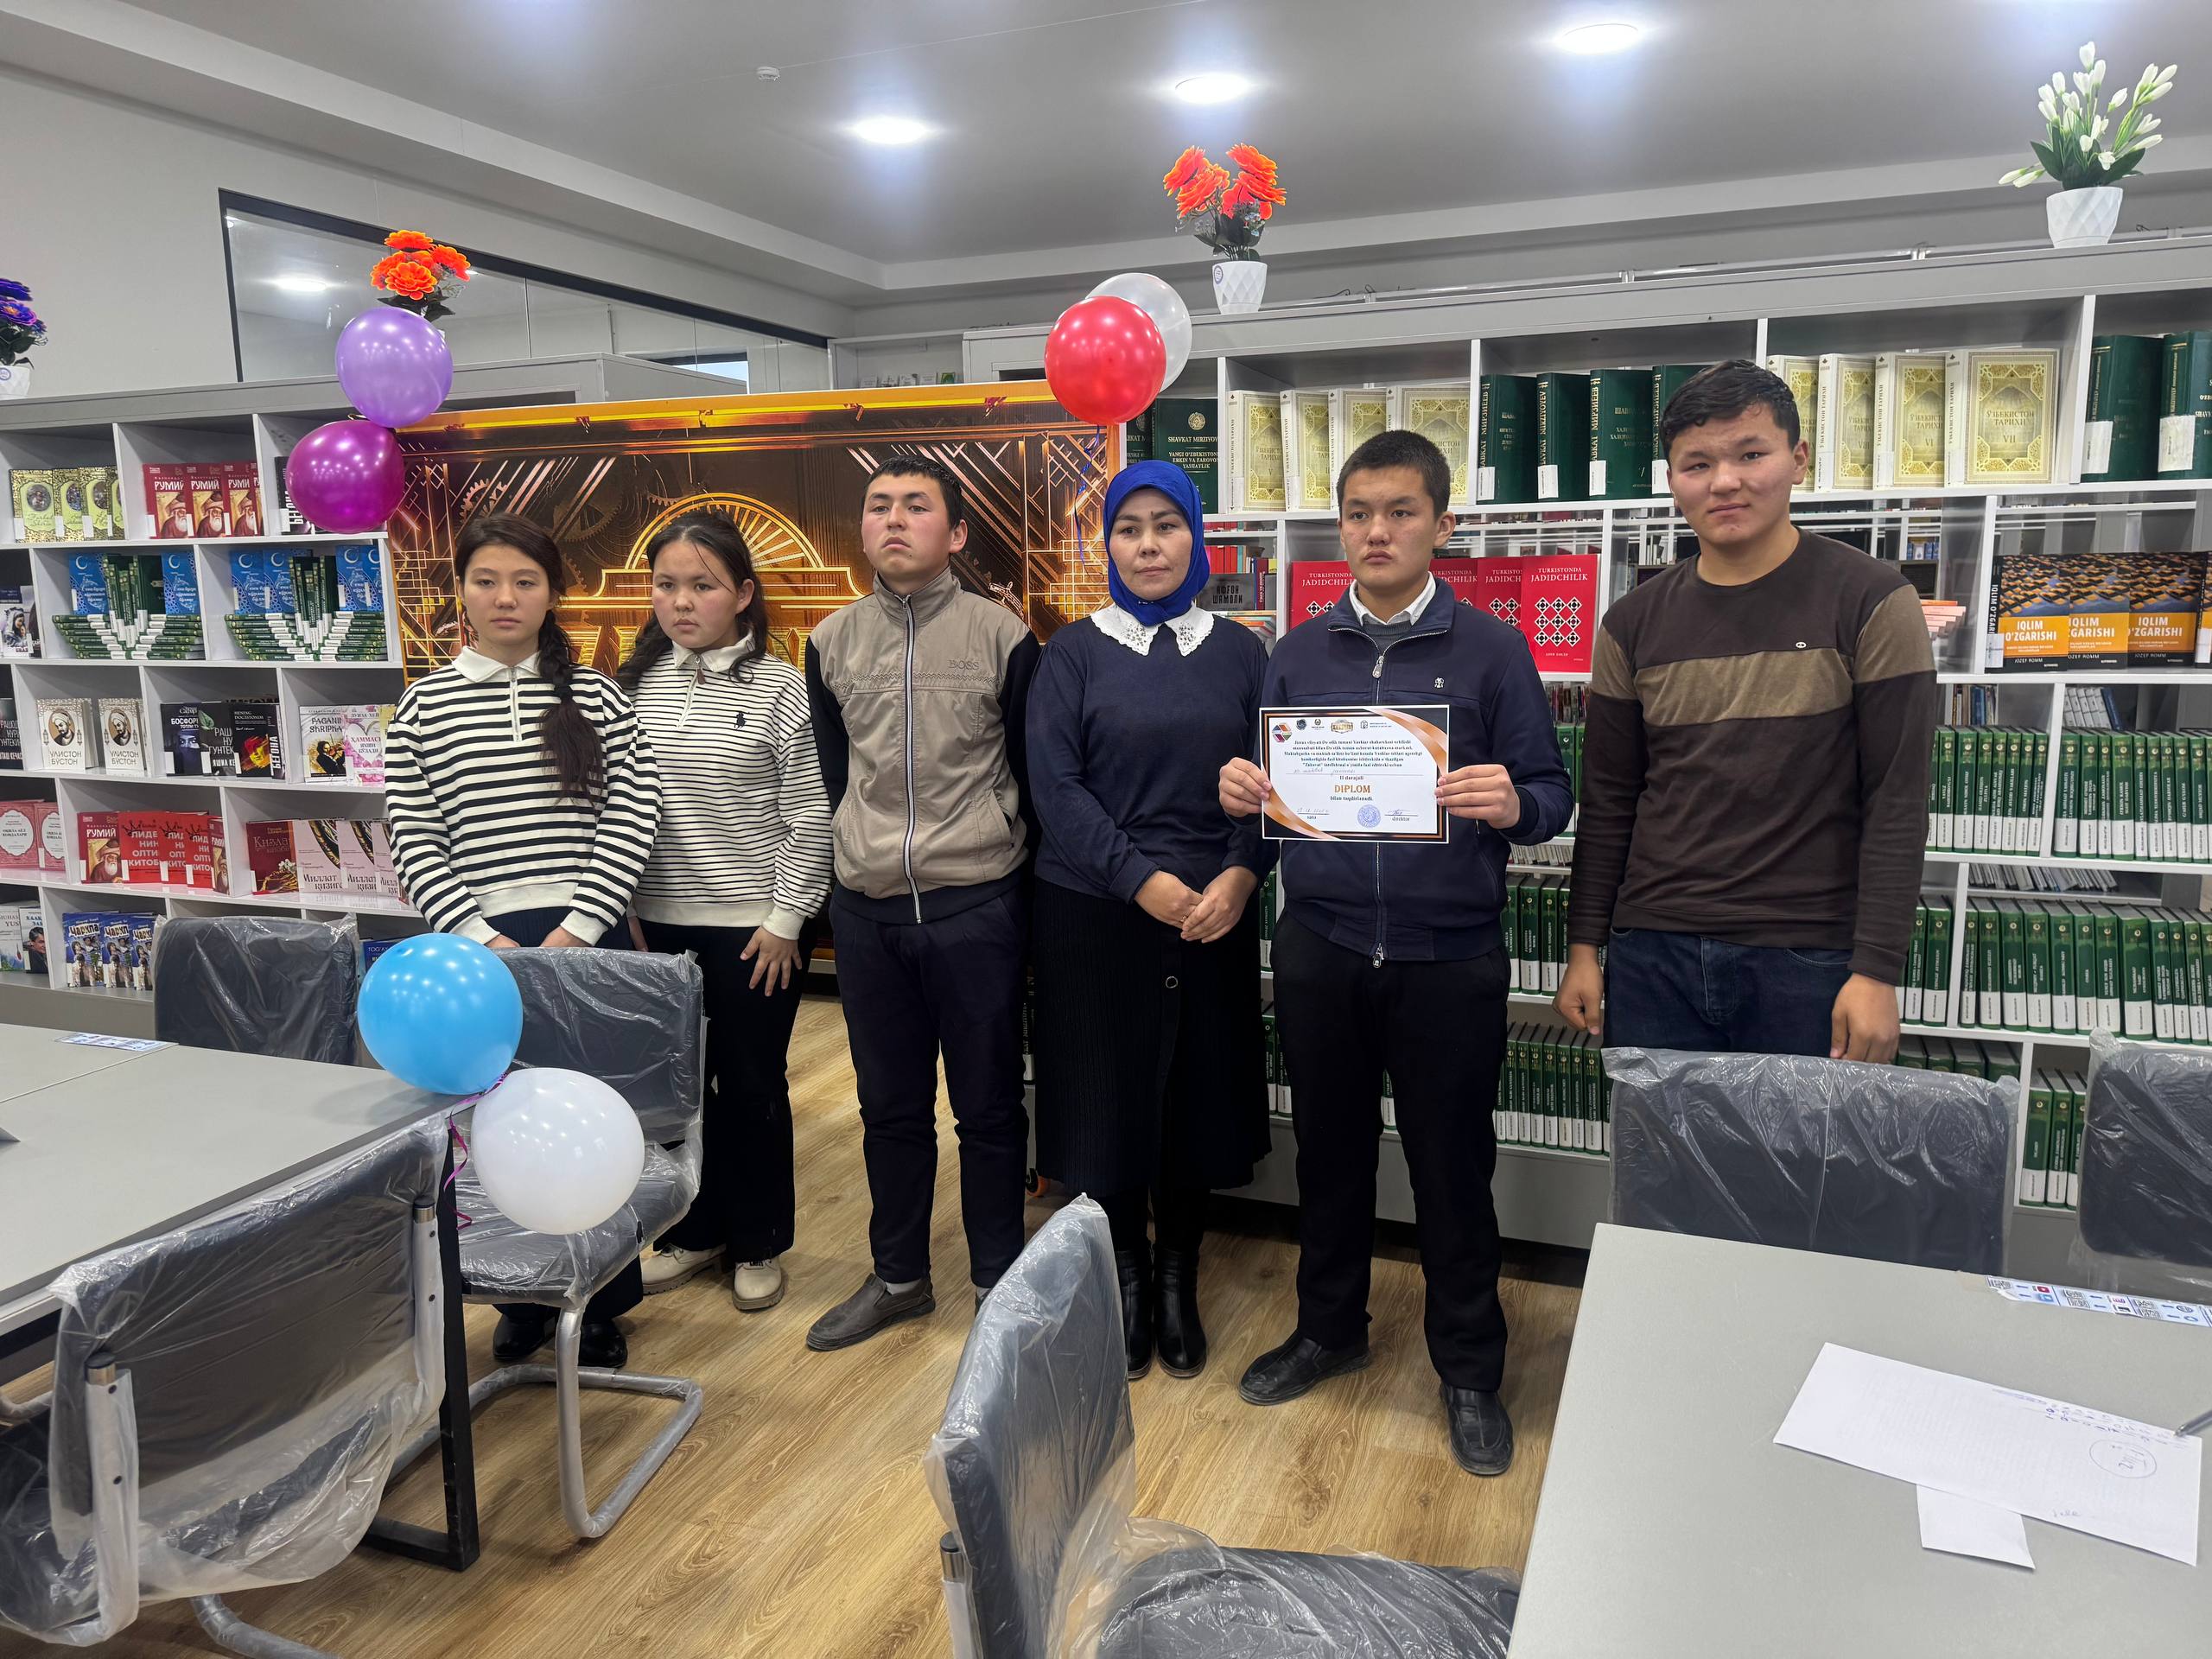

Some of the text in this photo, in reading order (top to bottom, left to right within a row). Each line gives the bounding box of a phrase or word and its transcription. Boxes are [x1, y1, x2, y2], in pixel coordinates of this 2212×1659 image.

[191, 479, 219, 490] РУМИЙ
[228, 479, 250, 488] РУМИ
[2018, 620, 2044, 630] IQLIM
[2069, 617, 2099, 626] IQLIM
[2139, 617, 2168, 626] IQLIM
[2005, 632, 2056, 641] O'ZGARISHI
[2069, 628, 2115, 638] GARISHI
[947, 659, 980, 671] BOSS
[214, 728, 232, 736] РАШ
[269, 735, 281, 769] БЕГОНА
[1334, 785, 1370, 793] DIPLOM
[86, 828, 117, 837] РУМИЙ
